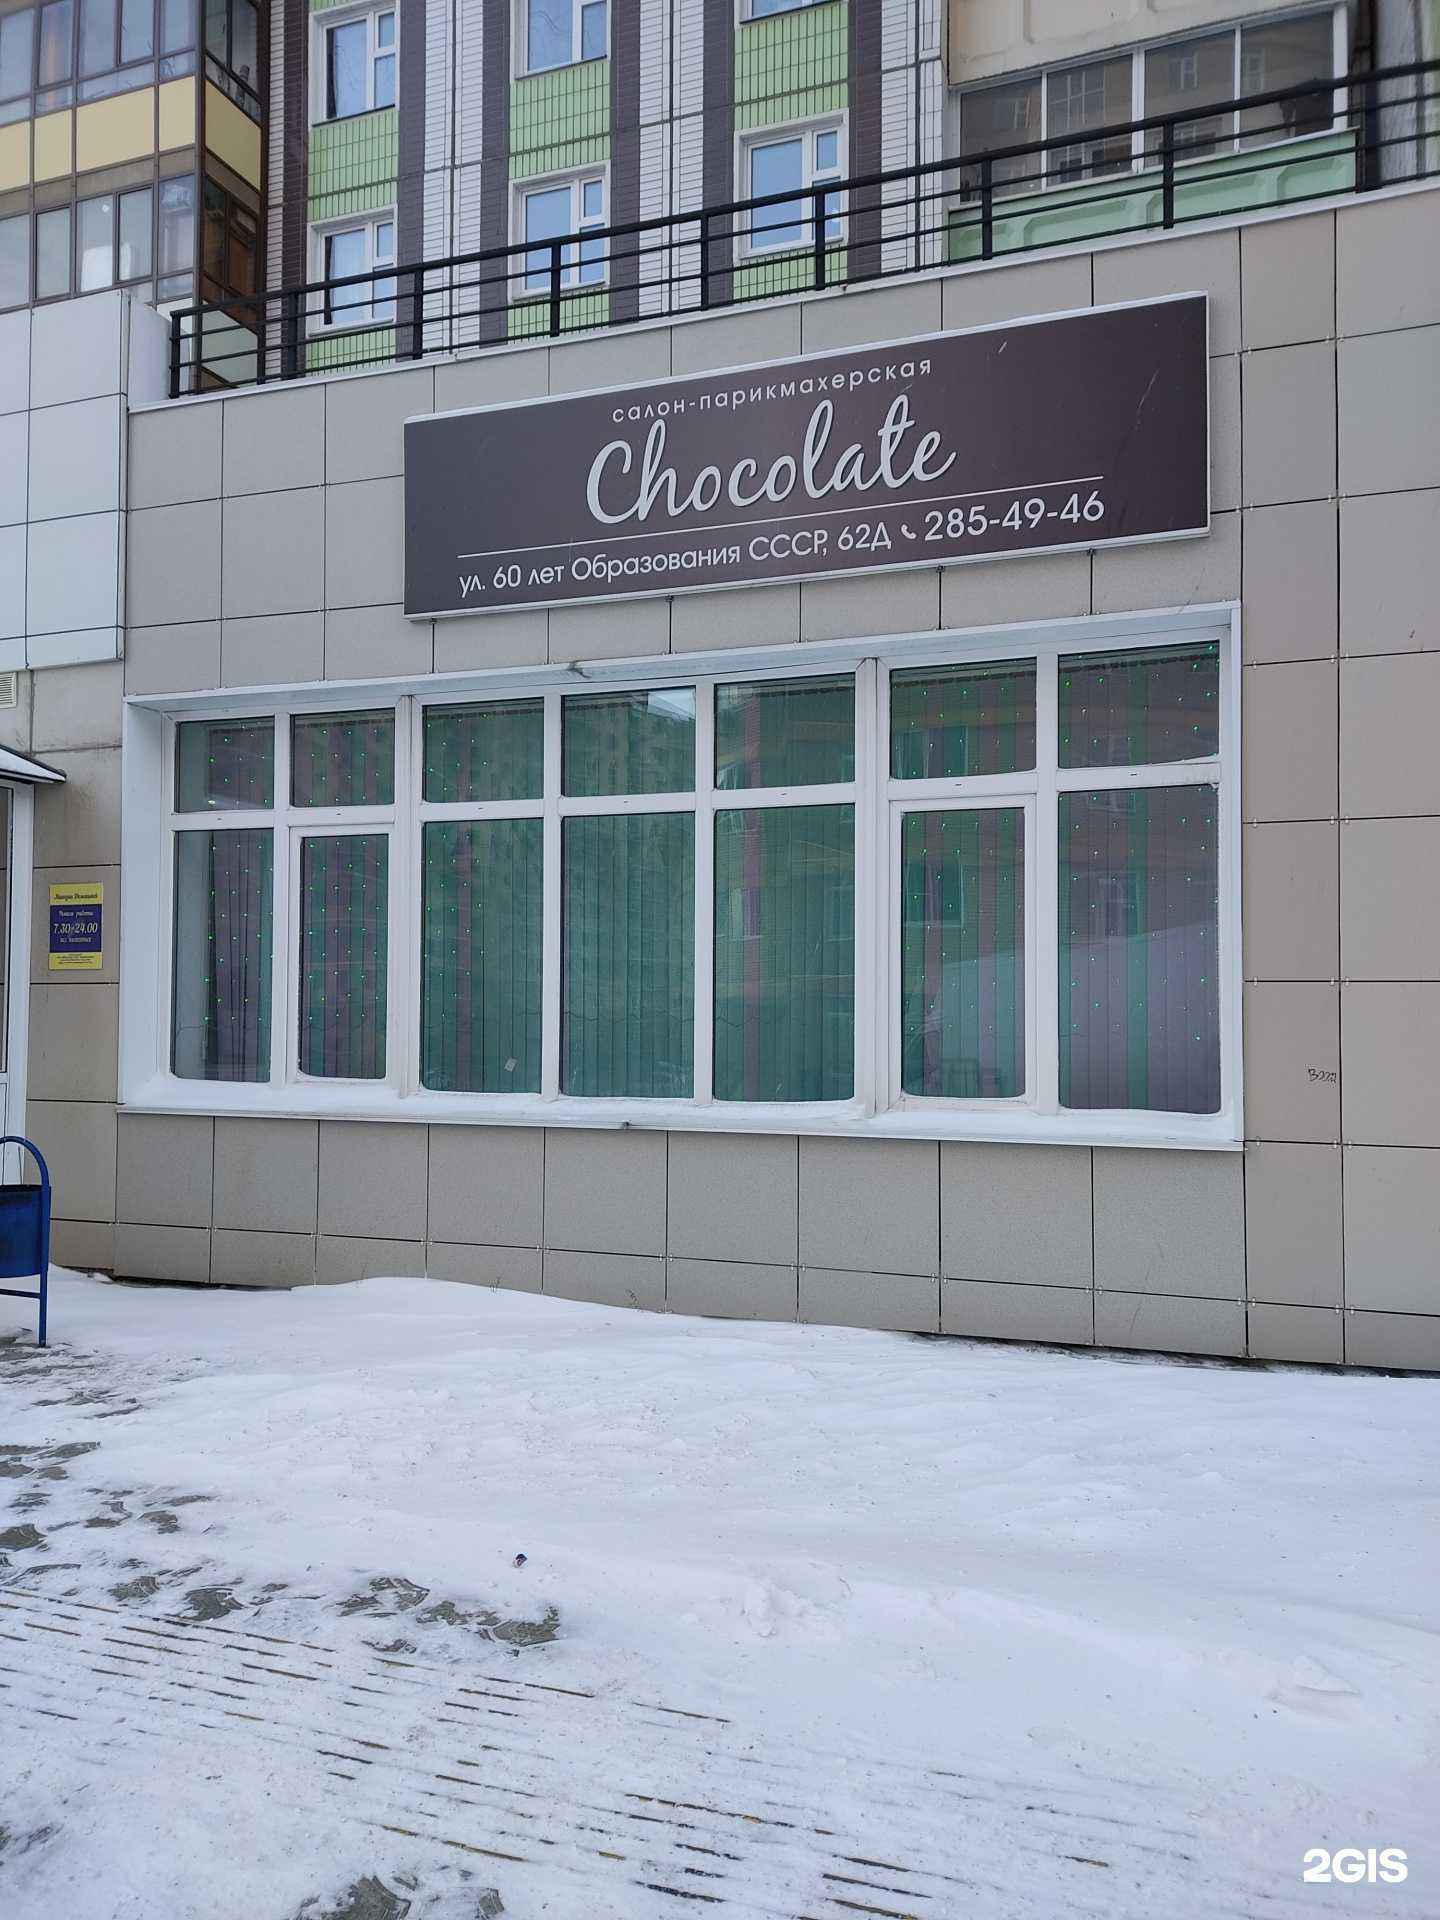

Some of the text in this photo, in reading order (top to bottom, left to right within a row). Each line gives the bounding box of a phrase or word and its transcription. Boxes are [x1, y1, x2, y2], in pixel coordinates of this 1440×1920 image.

[612, 358, 932, 423] салон-парикмахерская
[586, 394, 957, 524] Chocolate
[458, 489, 1106, 599] ул. 60 лет Образования СССР, 62Д 285-49-46
